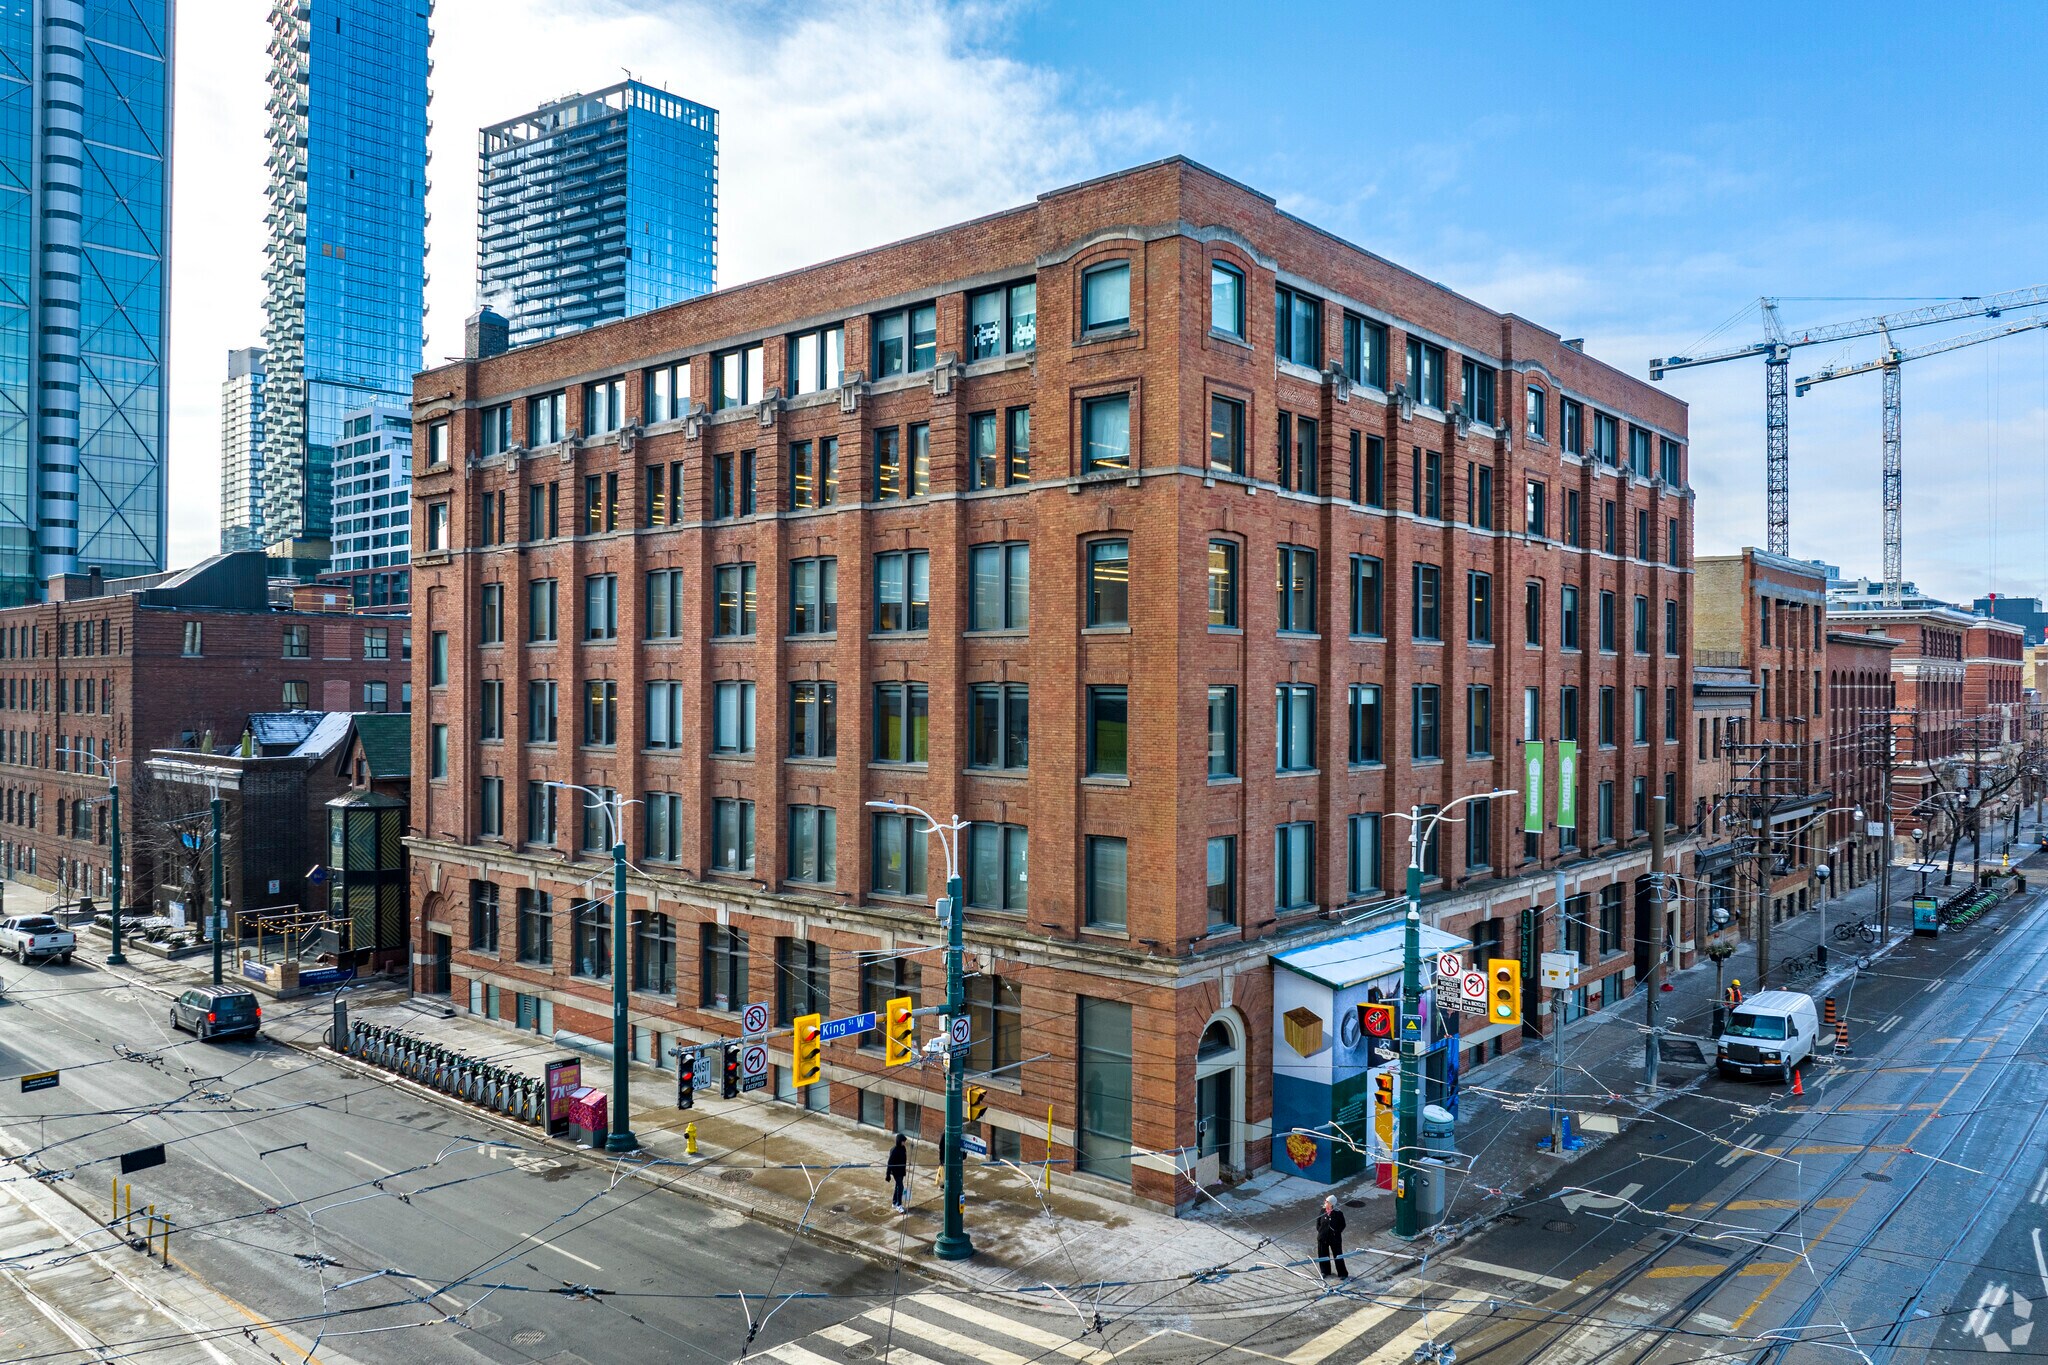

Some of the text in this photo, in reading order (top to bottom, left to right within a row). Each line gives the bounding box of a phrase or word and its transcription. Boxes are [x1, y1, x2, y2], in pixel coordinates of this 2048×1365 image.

[822, 1022, 846, 1036] King
[856, 1016, 865, 1028] W
[693, 1060, 710, 1074] ANSIT
[693, 1072, 708, 1087] GNAL
[552, 1085, 566, 1100] 7X
